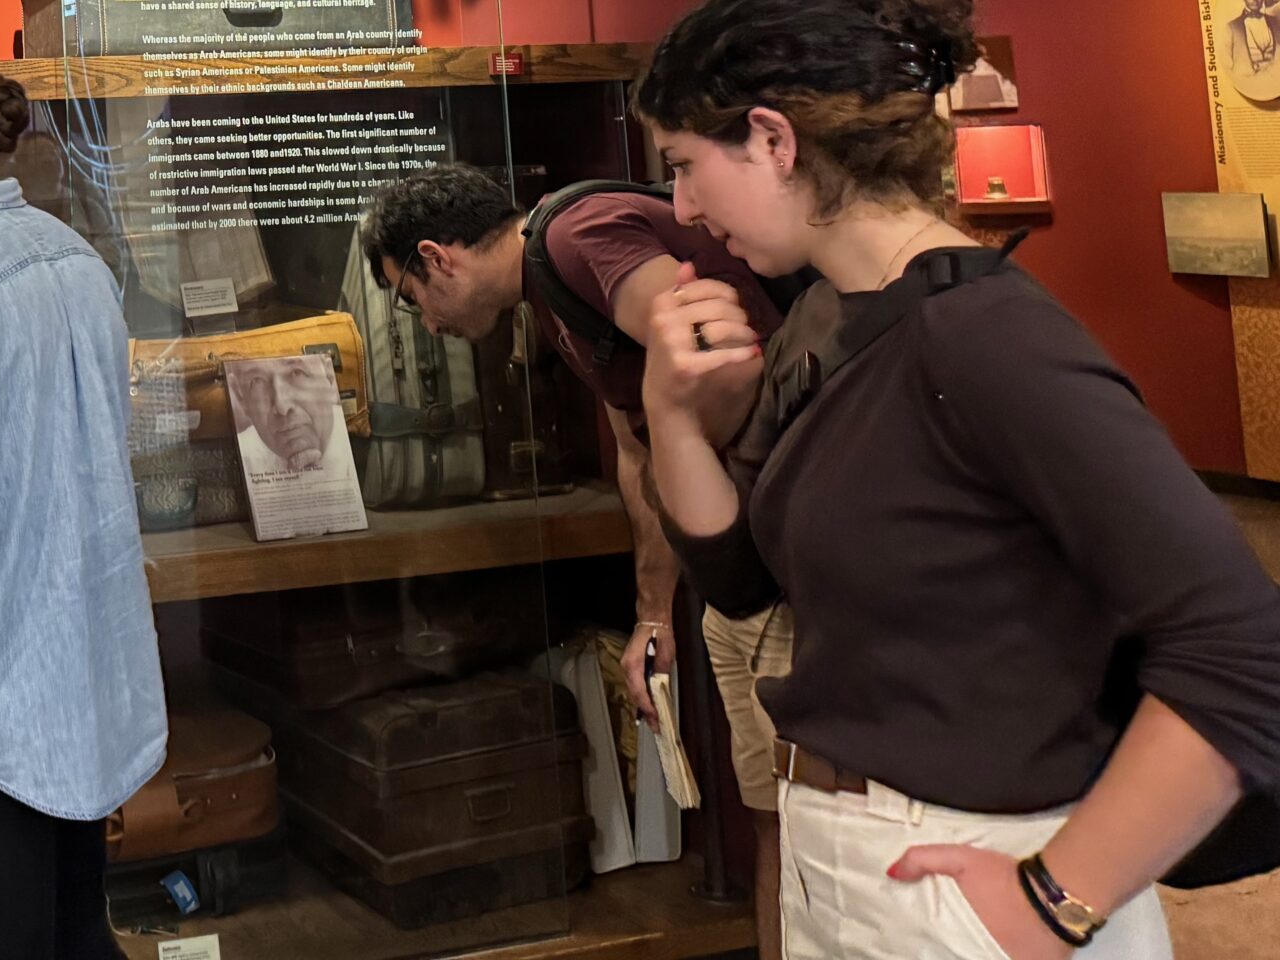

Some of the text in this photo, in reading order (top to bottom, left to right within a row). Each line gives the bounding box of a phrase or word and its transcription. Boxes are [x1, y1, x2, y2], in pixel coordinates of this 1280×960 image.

[142, 35, 177, 44] Whereas
[179, 34, 191, 43] the
[193, 34, 224, 44] majority
[226, 33, 234, 42] of
[235, 33, 247, 41] the
[249, 32, 274, 43] people
[276, 32, 292, 40] who
[317, 31, 334, 39] from
[347, 30, 364, 39] Arab
[366, 30, 393, 40] country
[395, 29, 422, 39] identify
[1205, 24, 1217, 71] Student:
[144, 69, 163, 78] such
[176, 68, 200, 78] Syrian
[202, 67, 243, 76] Americans
[255, 65, 296, 74] Palestinian
[299, 64, 340, 73] Americans.
[342, 63, 363, 72] Some
[365, 63, 385, 73] might
[387, 62, 415, 72] identify
[1209, 76, 1220, 97] and
[147, 111, 414, 129] Arabs have been coming to the United States for hundreds of years. Like
[148, 137, 174, 147] others,
[176, 136, 192, 146] they
[217, 134, 247, 145] seeking
[249, 133, 271, 142] better
[273, 131, 324, 142] opportunities.
[326, 130, 340, 139] The
[342, 130, 357, 138] first
[359, 128, 398, 139] significant
[399, 127, 426, 136] number
[429, 126, 436, 135] of
[1215, 102, 1226, 165] Missionary
[148, 153, 192, 164] immigrants
[216, 150, 249, 160] between
[252, 150, 268, 158] 1880
[304, 148, 320, 156] This
[322, 146, 349, 155] slowed
[351, 146, 371, 154] down
[374, 144, 412, 155] drastically
[415, 143, 445, 152] because
[150, 171, 157, 180] of
[159, 170, 198, 179] restrictive
[200, 168, 246, 179] immigration
[248, 167, 266, 175] laws
[269, 166, 295, 176] passed
[297, 165, 314, 173] after
[316, 164, 339, 173] World
[341, 163, 356, 172] War
[365, 162, 386, 171] Since
[388, 161, 399, 170] the
[401, 160, 423, 170] 1970s,
[150, 188, 179, 197] number
[182, 187, 188, 195] of
[191, 186, 209, 195] Arab
[211, 184, 252, 194] Americans
[254, 184, 268, 192] has
[270, 182, 306, 191] increased
[309, 181, 334, 191] rapidly
[337, 180, 351, 188] due
[352, 179, 359, 188] to
[151, 206, 165, 214] and
[168, 204, 200, 213] because
[202, 203, 209, 212] of
[233, 202, 247, 210] and
[249, 200, 286, 209] economic
[288, 198, 325, 209] hardships
[327, 197, 334, 206] in
[152, 222, 189, 231] estimated
[192, 221, 206, 229] that
[208, 220, 217, 230] by
[220, 219, 236, 228] 2000
[238, 218, 258, 227] there
[282, 216, 302, 225] about
[304, 215, 314, 223] 4.2
[317, 213, 342, 223] million
